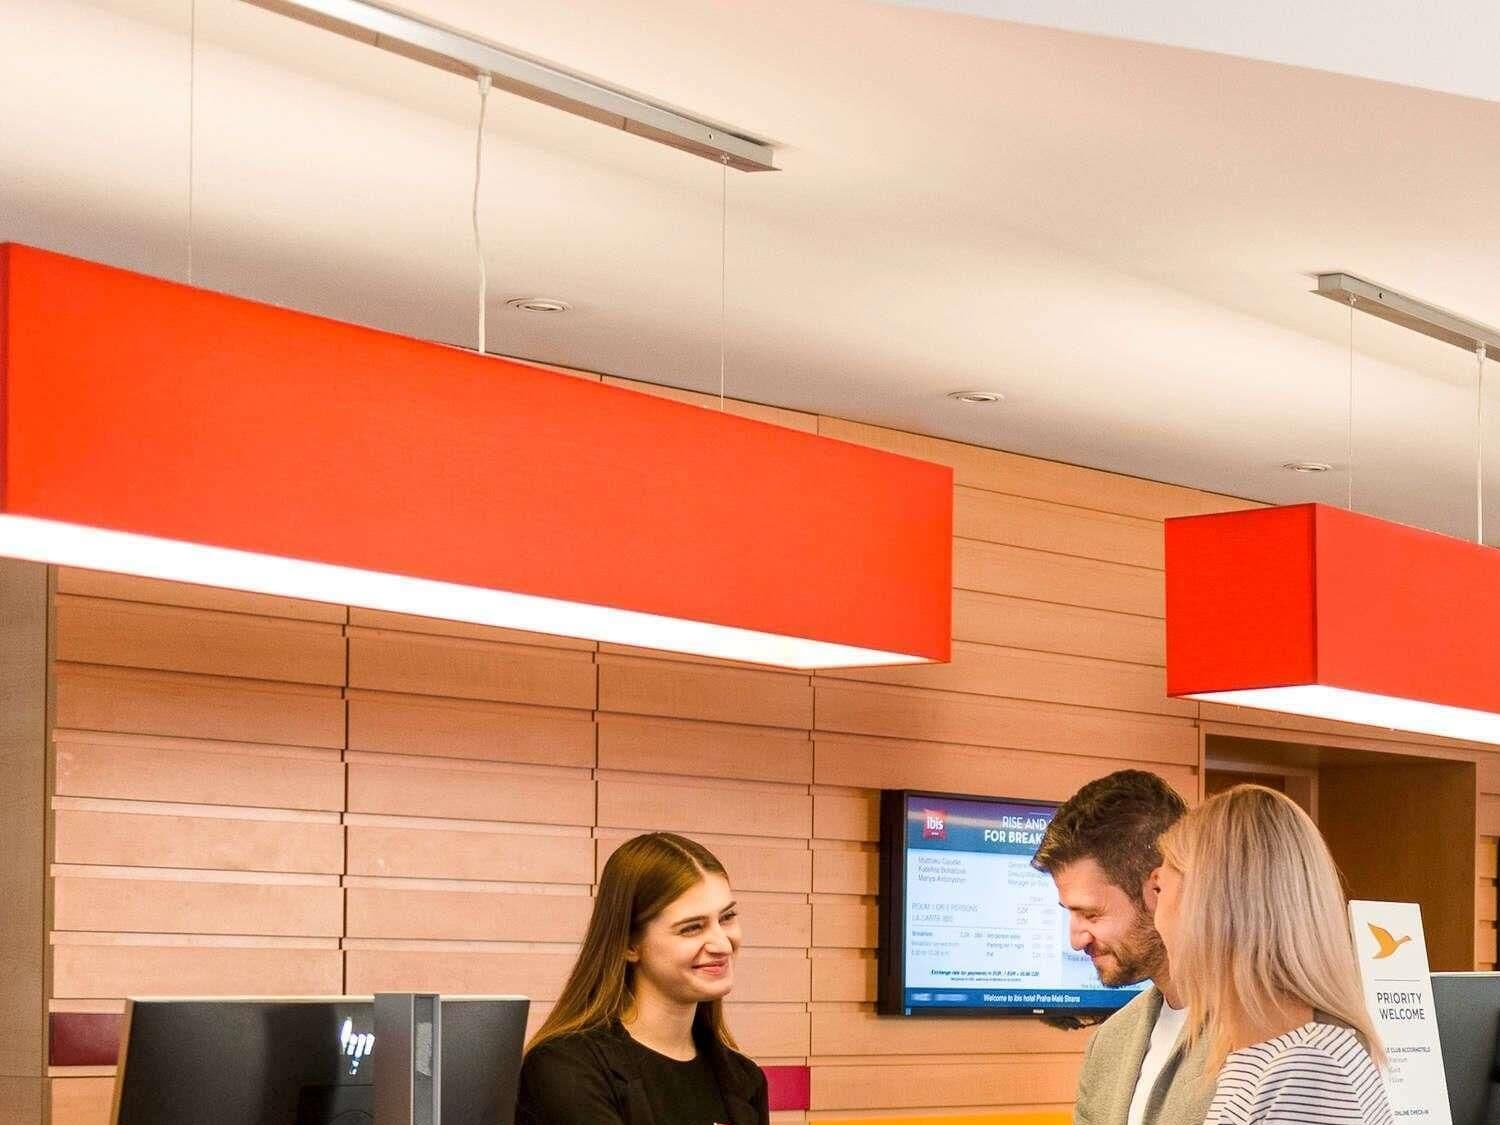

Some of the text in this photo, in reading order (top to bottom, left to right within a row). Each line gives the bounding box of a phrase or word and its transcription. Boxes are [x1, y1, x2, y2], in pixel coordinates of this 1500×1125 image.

[926, 815, 944, 831] ibis
[1002, 815, 1023, 829] RISE
[1025, 818, 1047, 831] AND
[984, 830, 1006, 843] FOR
[983, 993, 1007, 1003] Welcome
[1376, 991, 1422, 1005] PRIORITY
[1379, 1008, 1425, 1020] WELCOME
[340, 1015, 376, 1076] hp
